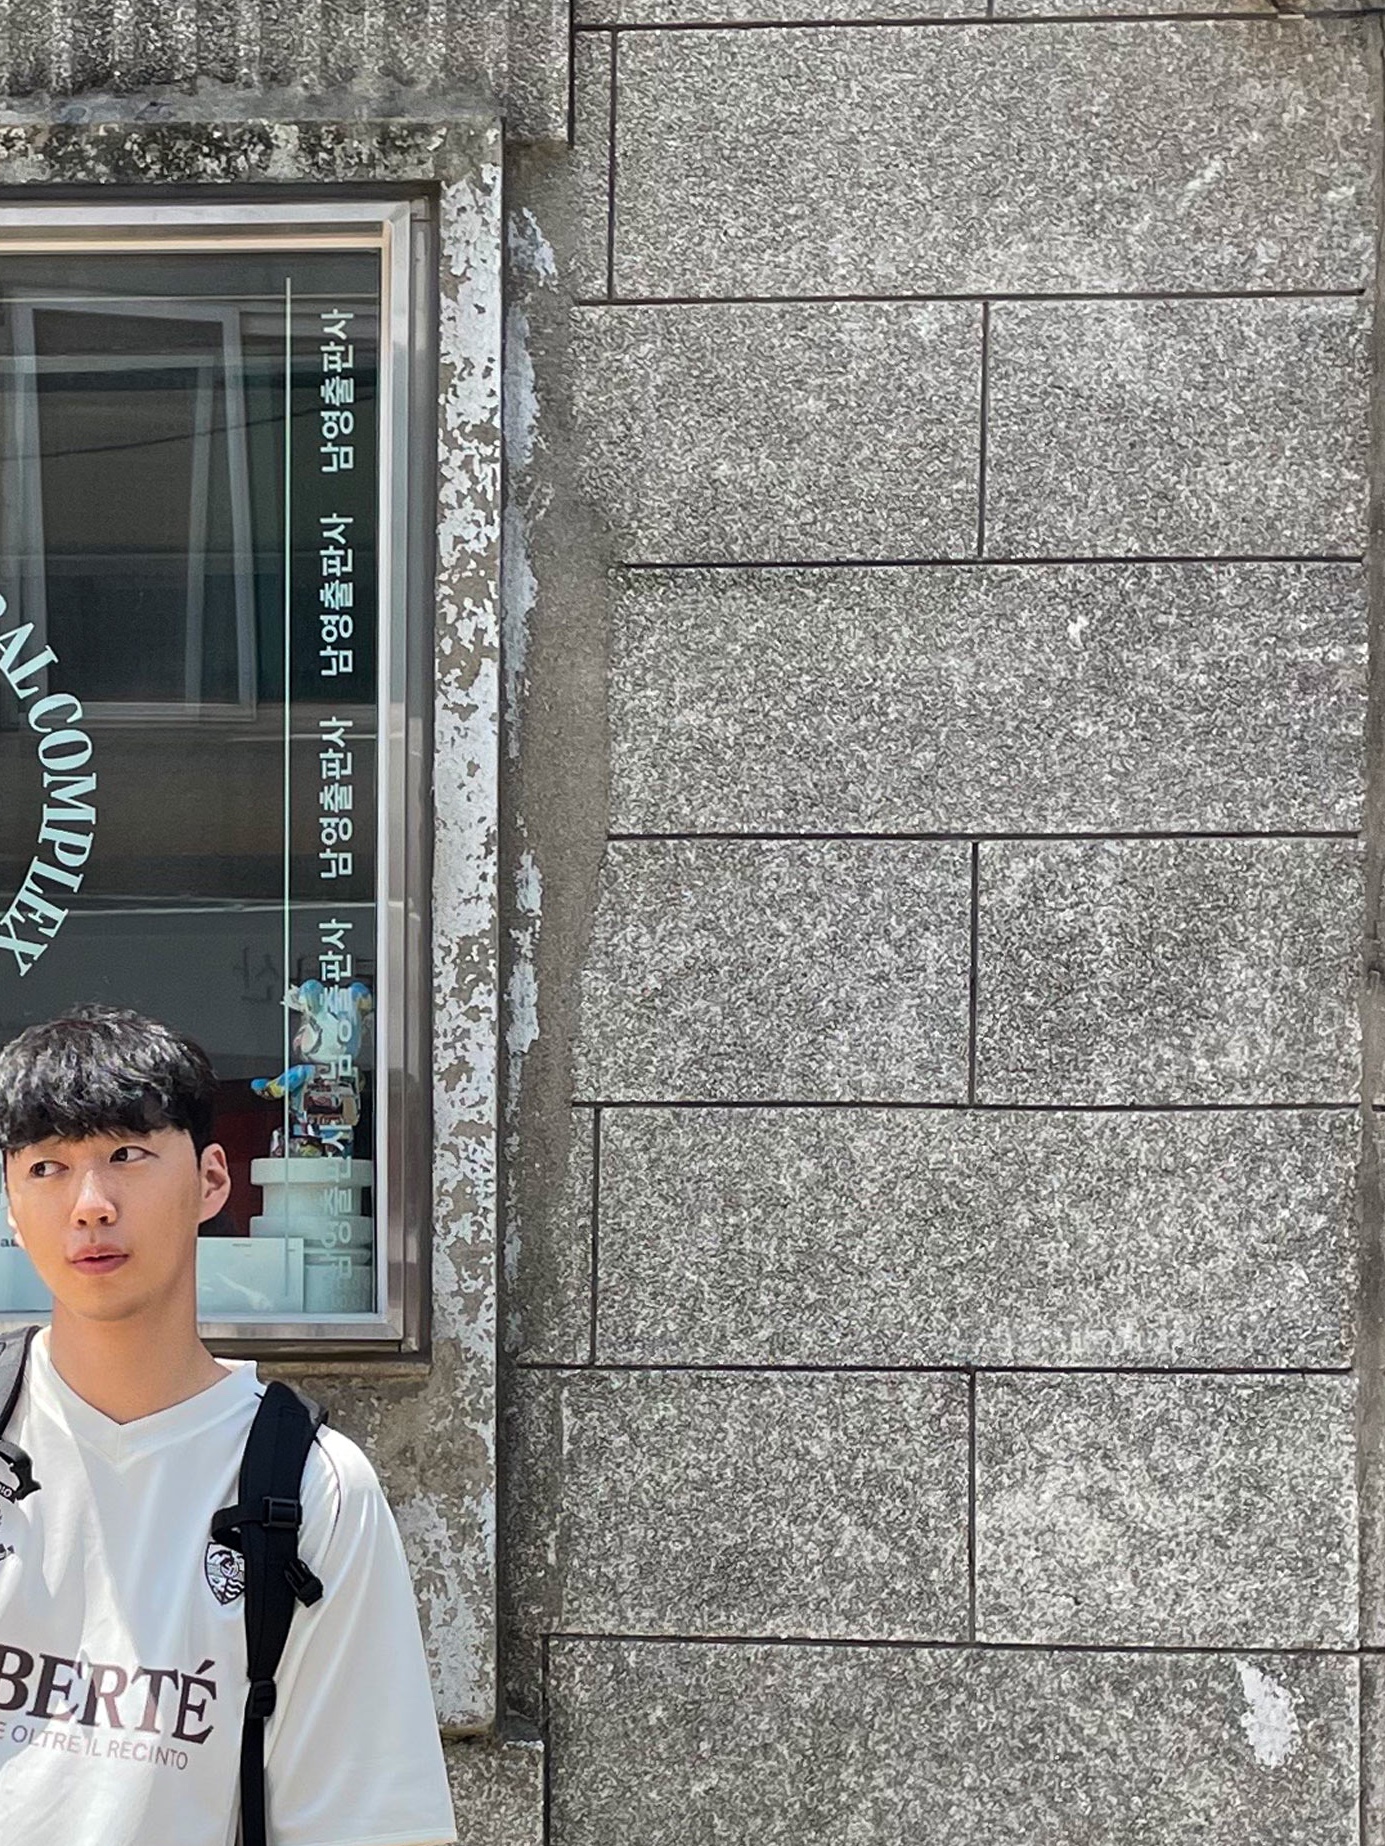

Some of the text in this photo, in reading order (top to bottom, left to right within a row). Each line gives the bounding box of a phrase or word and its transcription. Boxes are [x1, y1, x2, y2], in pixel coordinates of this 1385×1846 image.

[319, 309, 354, 472] 남영출판사
[319, 513, 354, 676] 남영출판사
[319, 716, 353, 878] 남영출판사
[11, 1724, 83, 1754] OLTRE
[83, 1737, 103, 1758] IL
[107, 1739, 189, 1771] RECINTO
